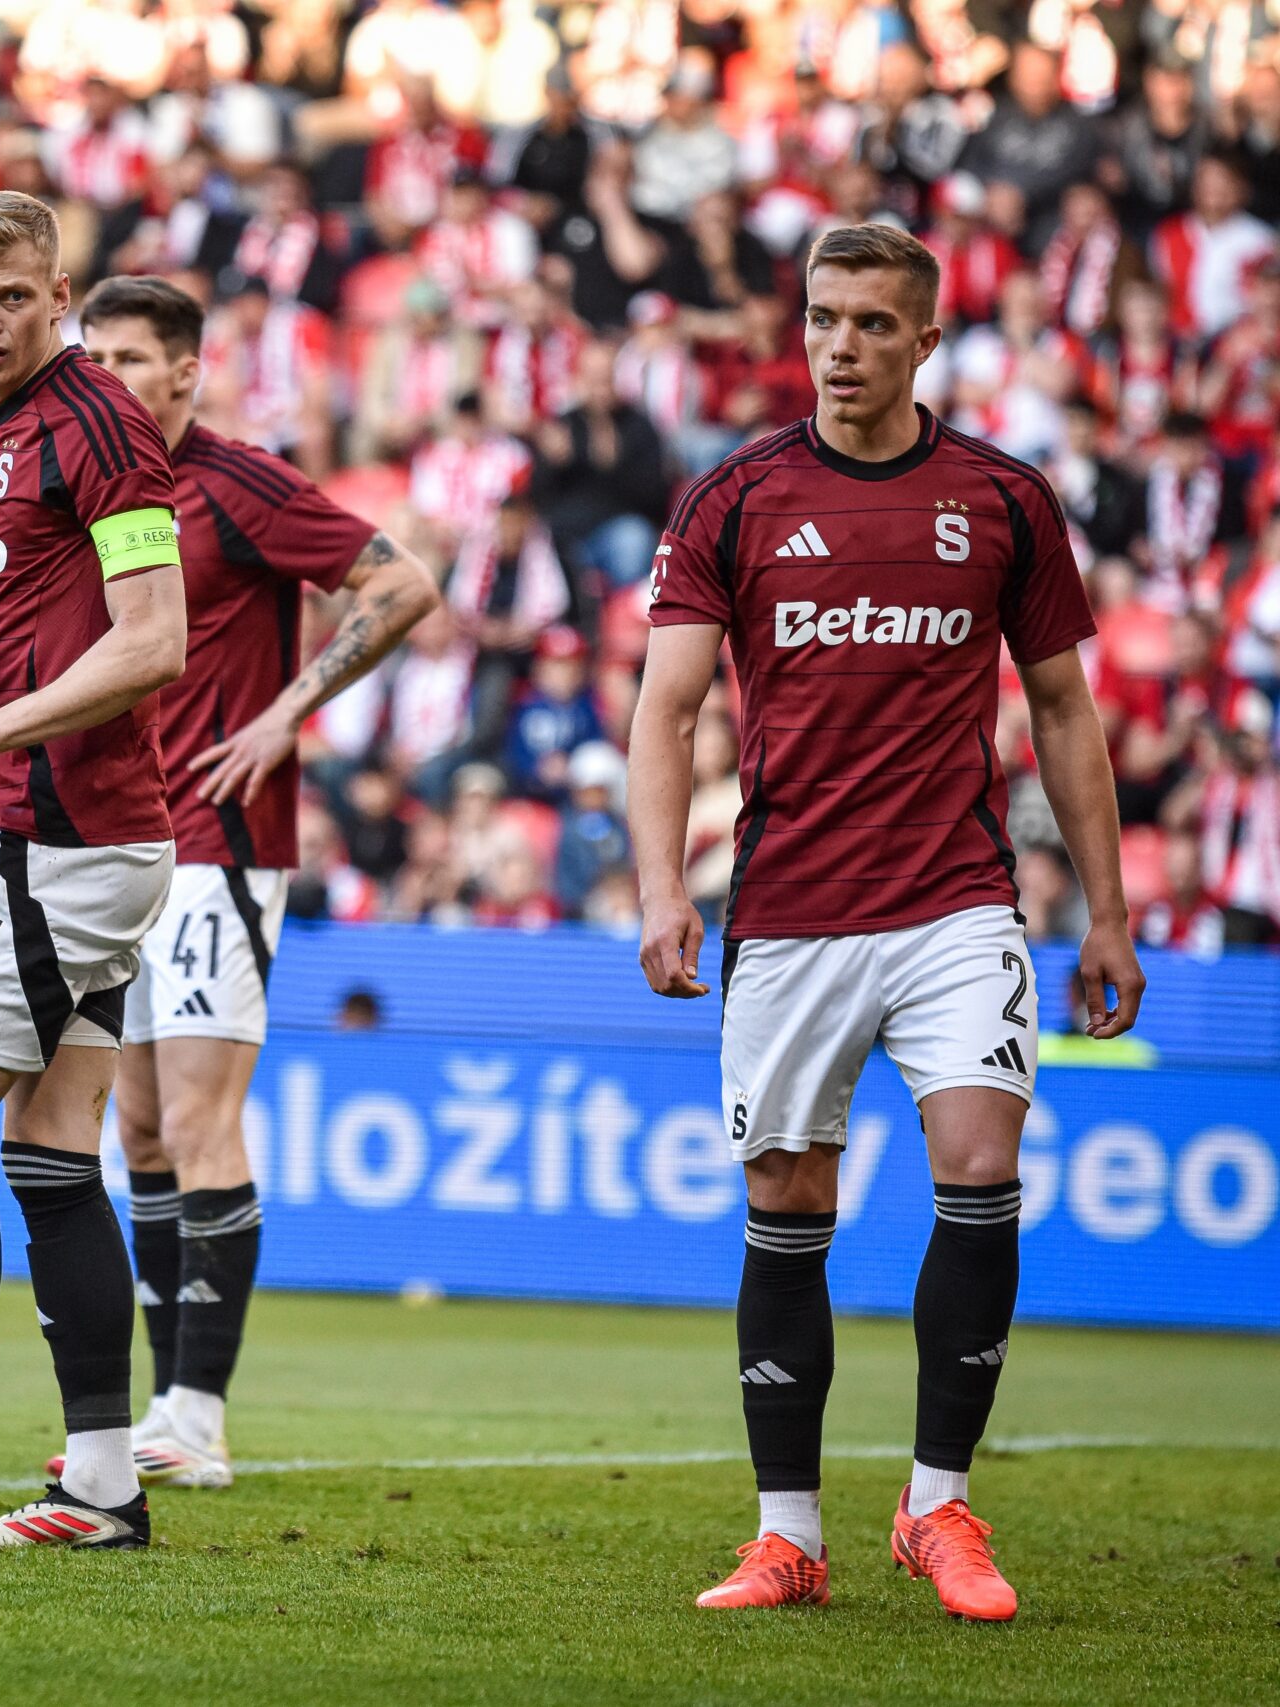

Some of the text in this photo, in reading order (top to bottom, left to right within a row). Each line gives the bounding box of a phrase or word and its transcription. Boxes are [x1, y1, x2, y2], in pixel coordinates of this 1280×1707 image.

[143, 530, 177, 544] RESPE
[934, 514, 971, 562] S
[774, 597, 973, 648] Betano
[172, 912, 220, 979] 41
[1001, 951, 1028, 1028] 2
[100, 1055, 746, 1222] ložíte
